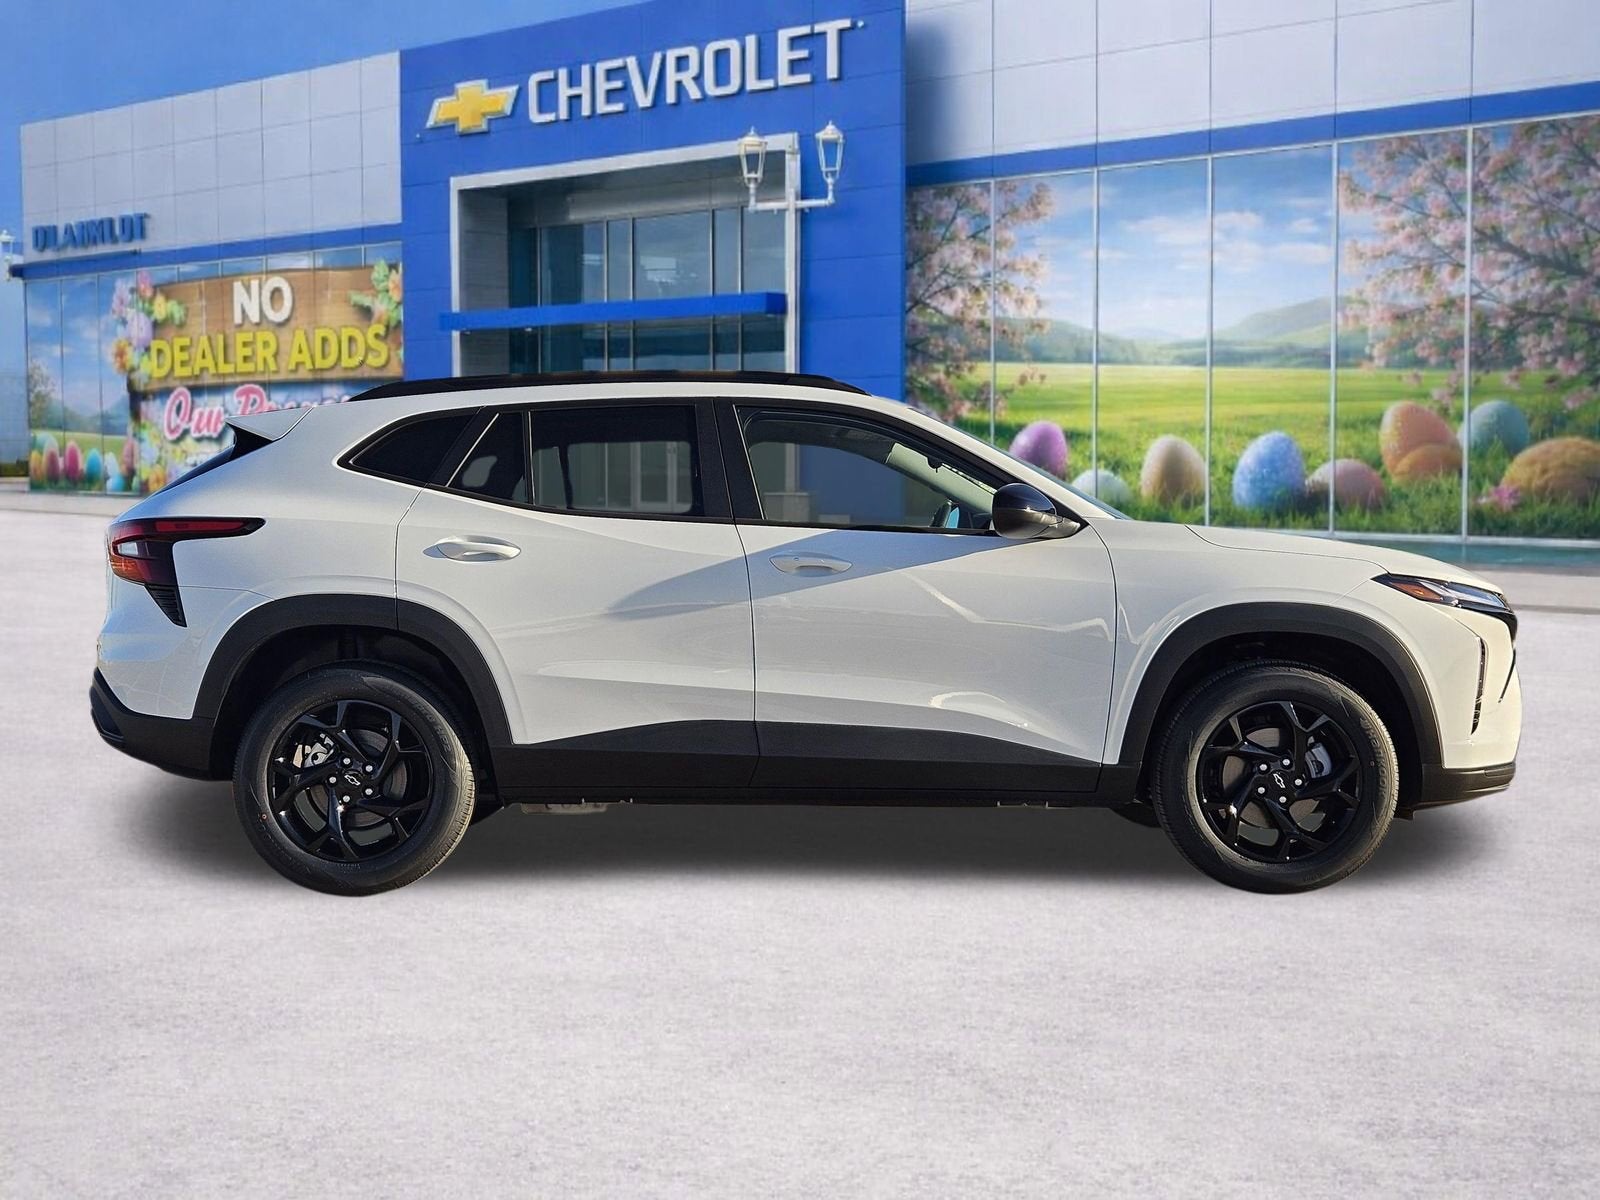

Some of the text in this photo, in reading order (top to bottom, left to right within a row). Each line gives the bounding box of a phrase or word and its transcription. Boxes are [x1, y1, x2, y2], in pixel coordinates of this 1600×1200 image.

[528, 18, 852, 124] CHEVROLET
[232, 275, 294, 326] NO
[150, 323, 389, 379] DEALER ADDS
